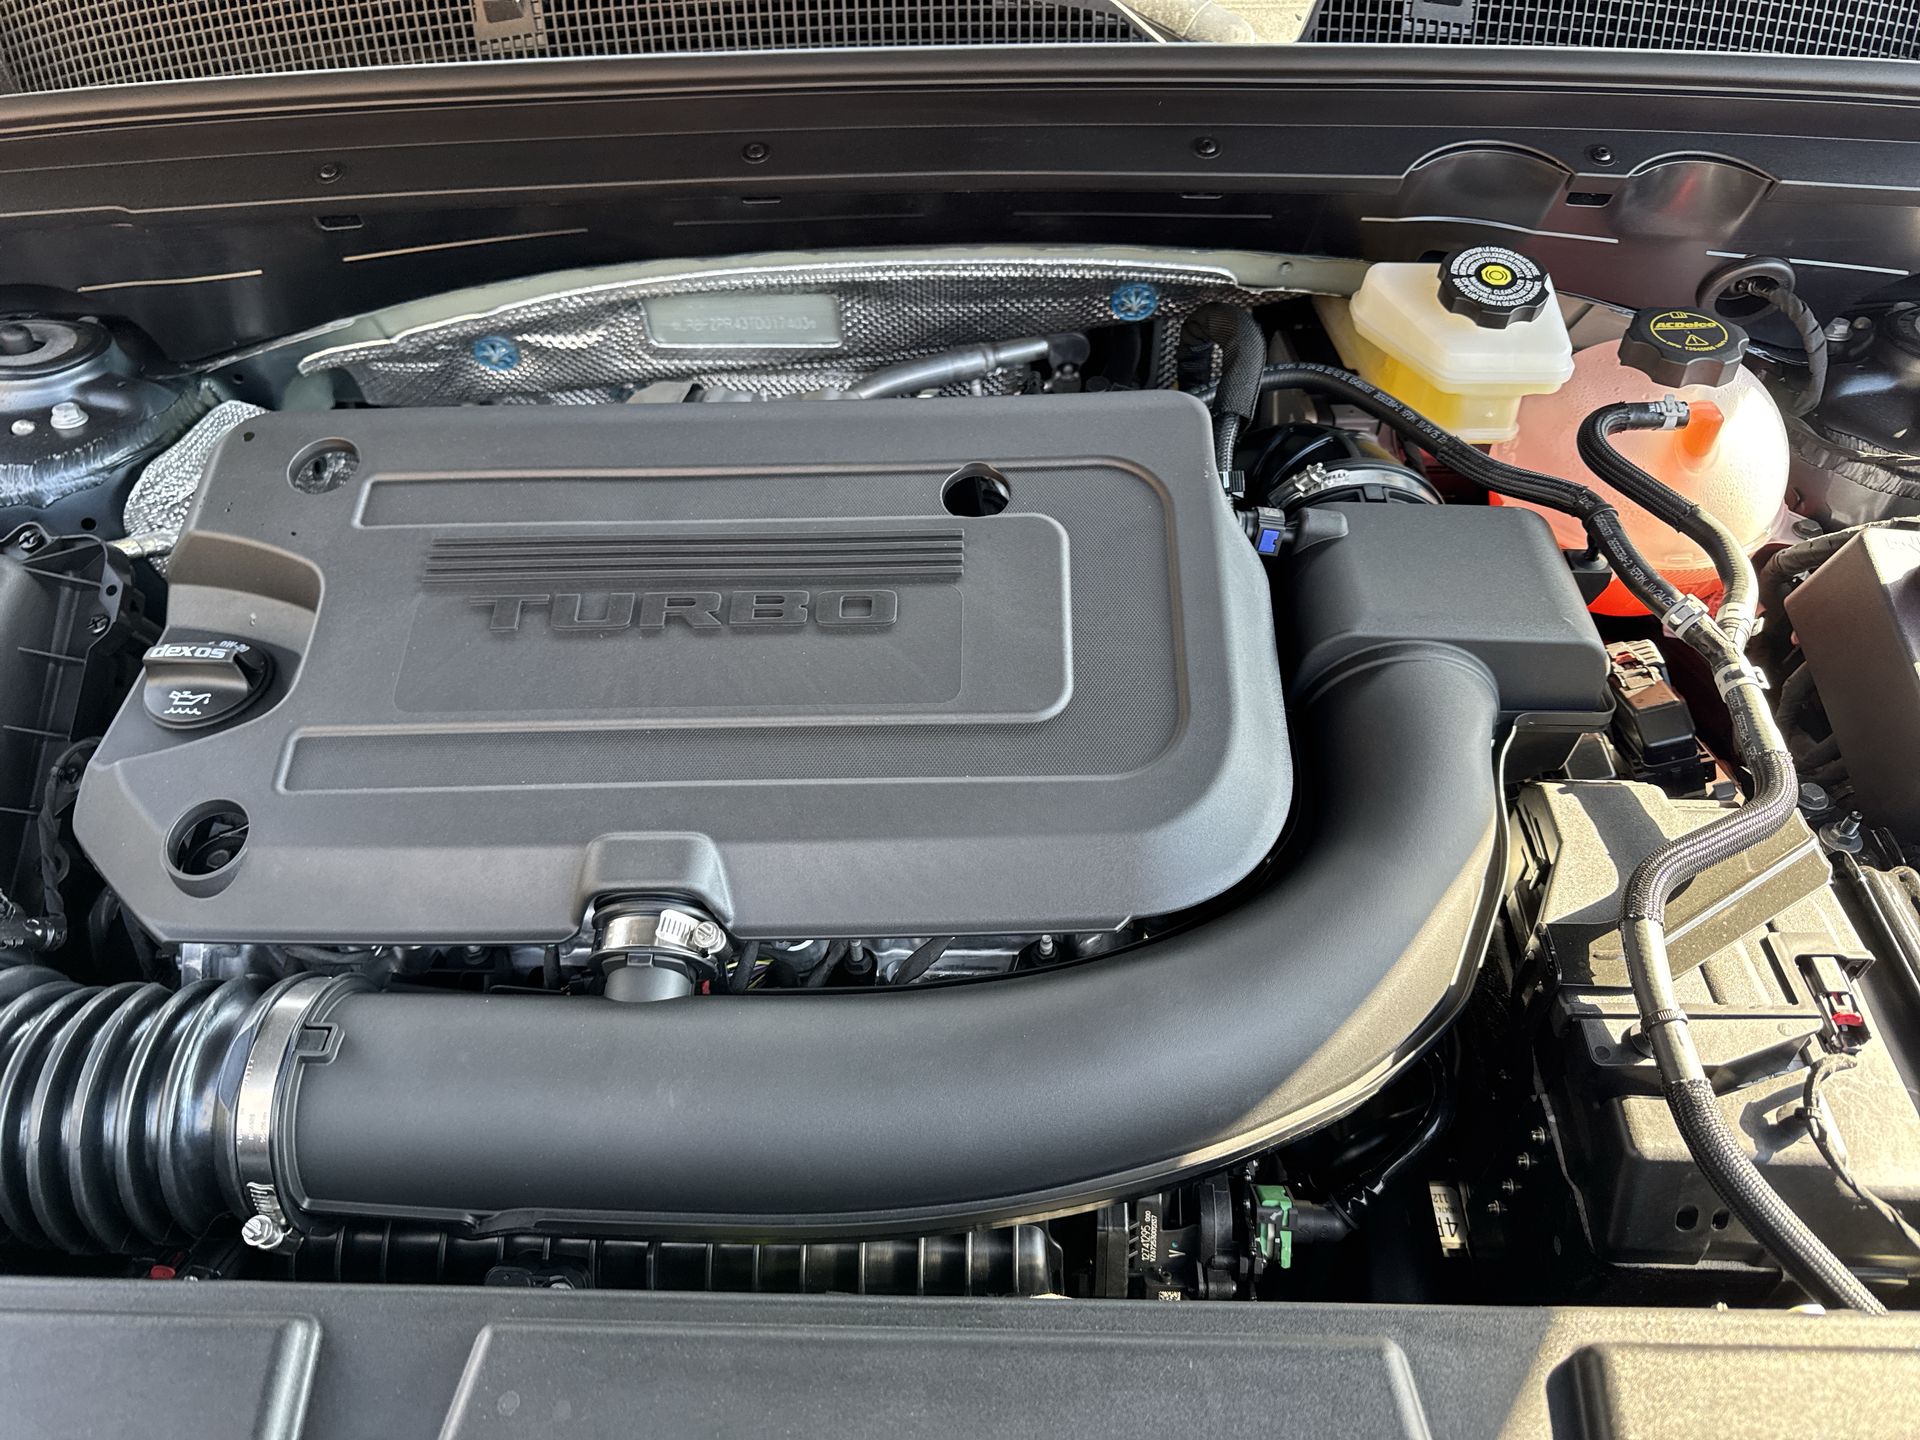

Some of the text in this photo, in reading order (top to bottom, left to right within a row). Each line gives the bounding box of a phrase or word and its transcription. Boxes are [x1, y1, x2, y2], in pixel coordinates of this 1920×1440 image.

[1655, 321, 1717, 330] ACDelco
[469, 589, 899, 632] TURBO
[149, 643, 228, 659] dexos
